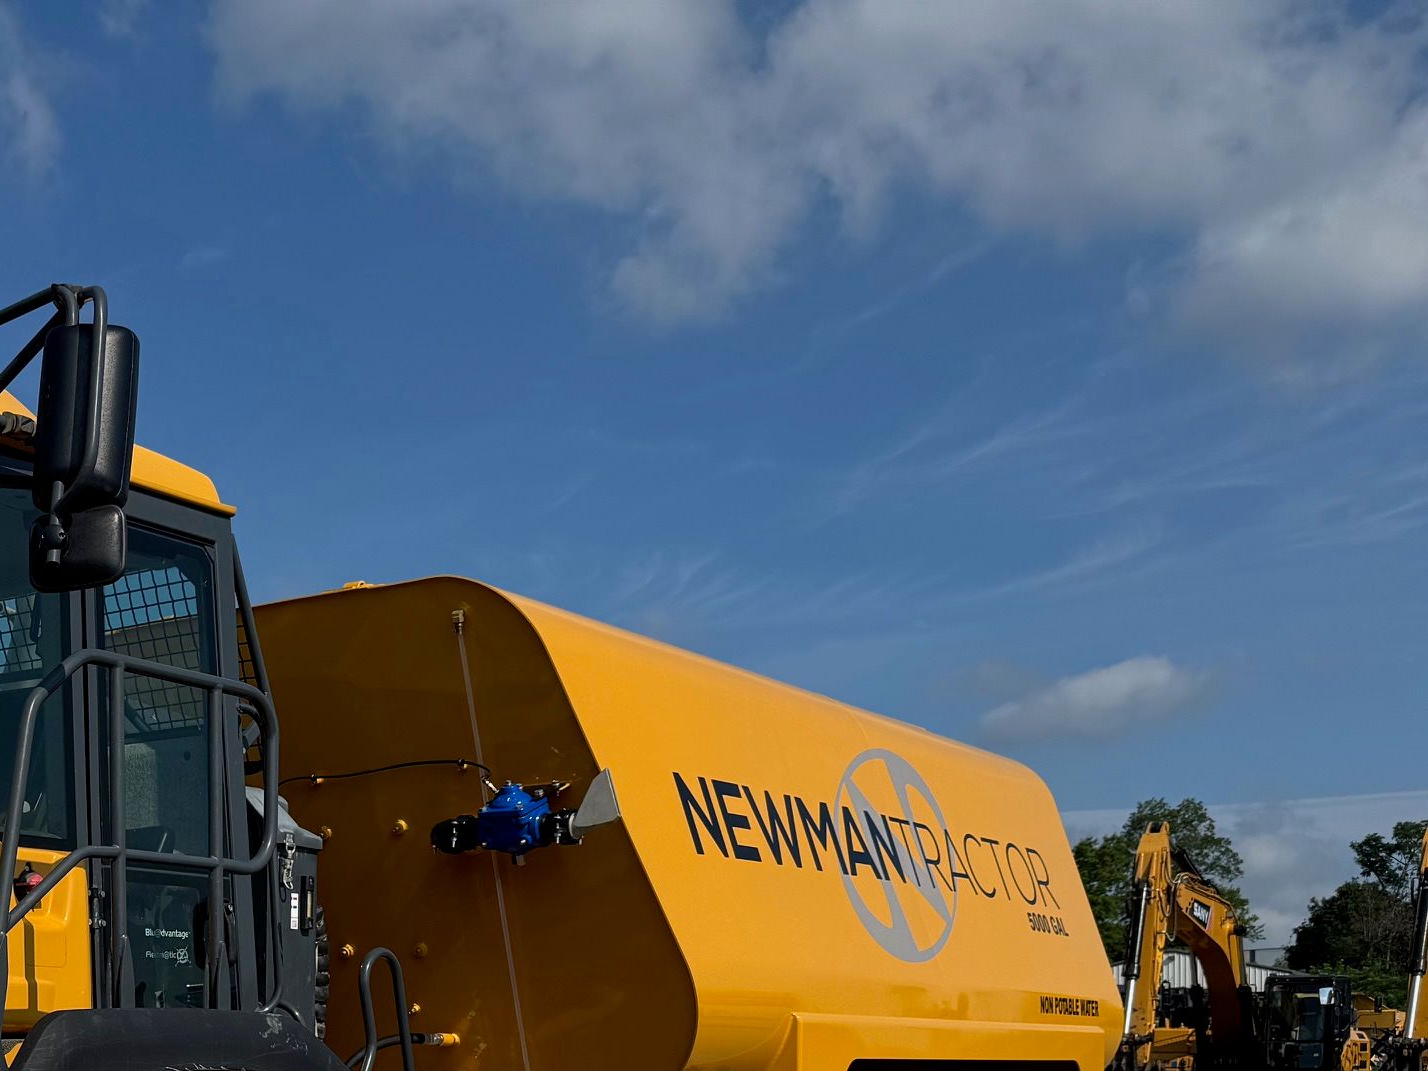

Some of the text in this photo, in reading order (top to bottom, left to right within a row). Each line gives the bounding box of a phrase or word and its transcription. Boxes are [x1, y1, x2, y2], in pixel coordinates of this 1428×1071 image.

[1027, 911, 1070, 937] 5000 GAL
[1193, 901, 1210, 924] SANY
[1039, 995, 1100, 1017] NON POTABLE WATER
